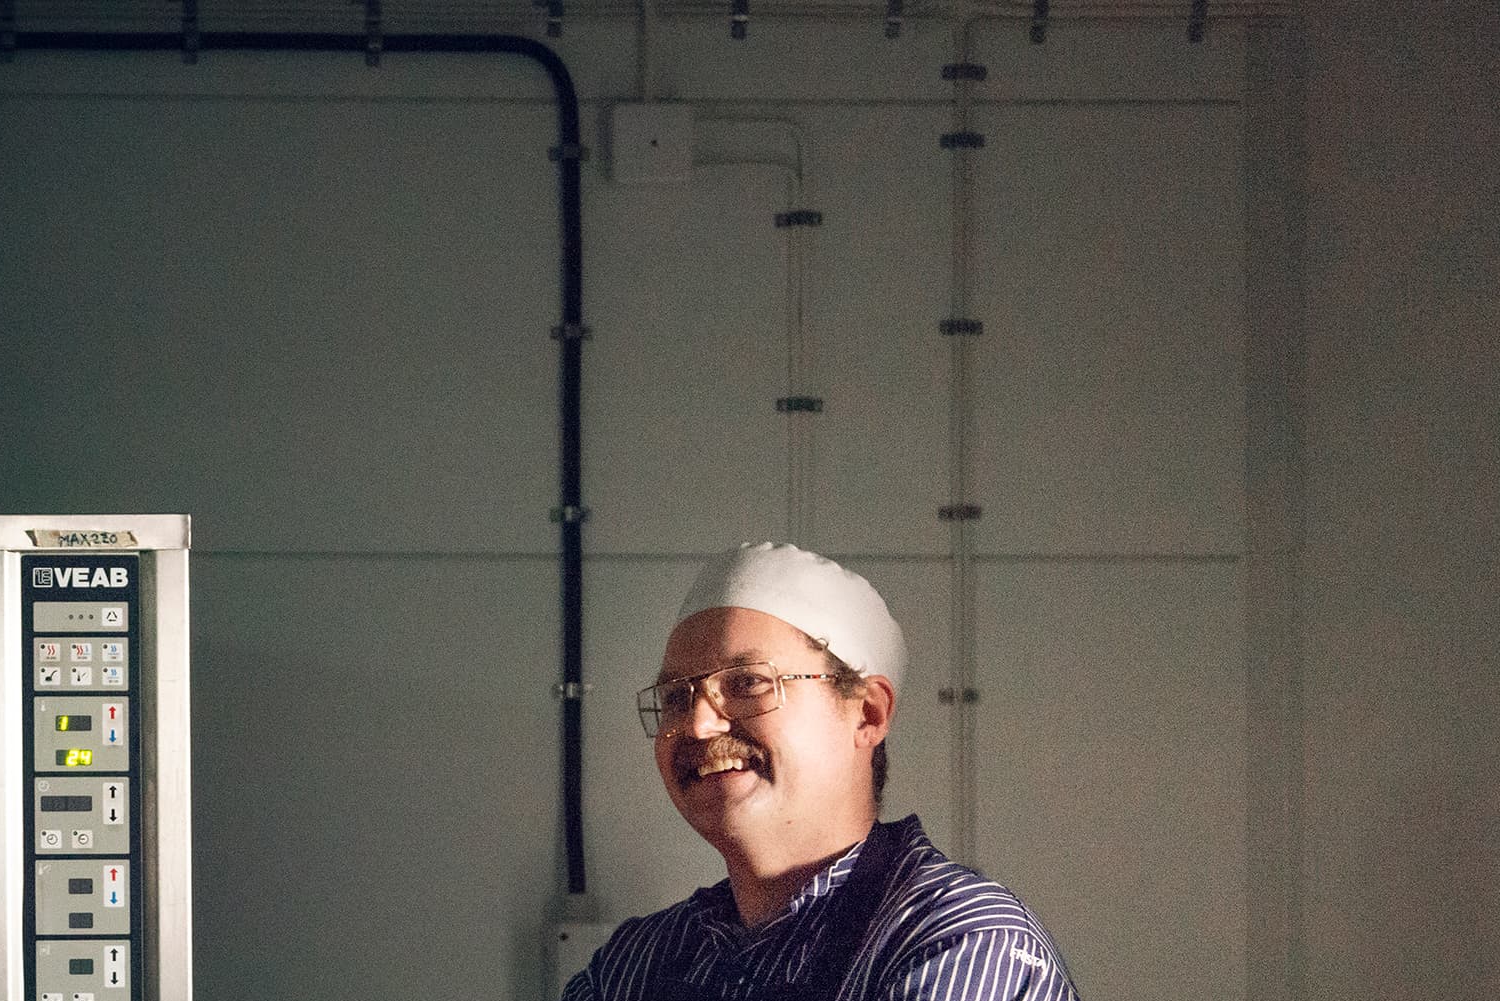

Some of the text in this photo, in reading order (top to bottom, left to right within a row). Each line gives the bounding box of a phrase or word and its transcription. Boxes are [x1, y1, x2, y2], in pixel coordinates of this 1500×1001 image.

[58, 531, 91, 547] MAX
[54, 567, 129, 588] VEAB
[65, 749, 93, 766] 24
